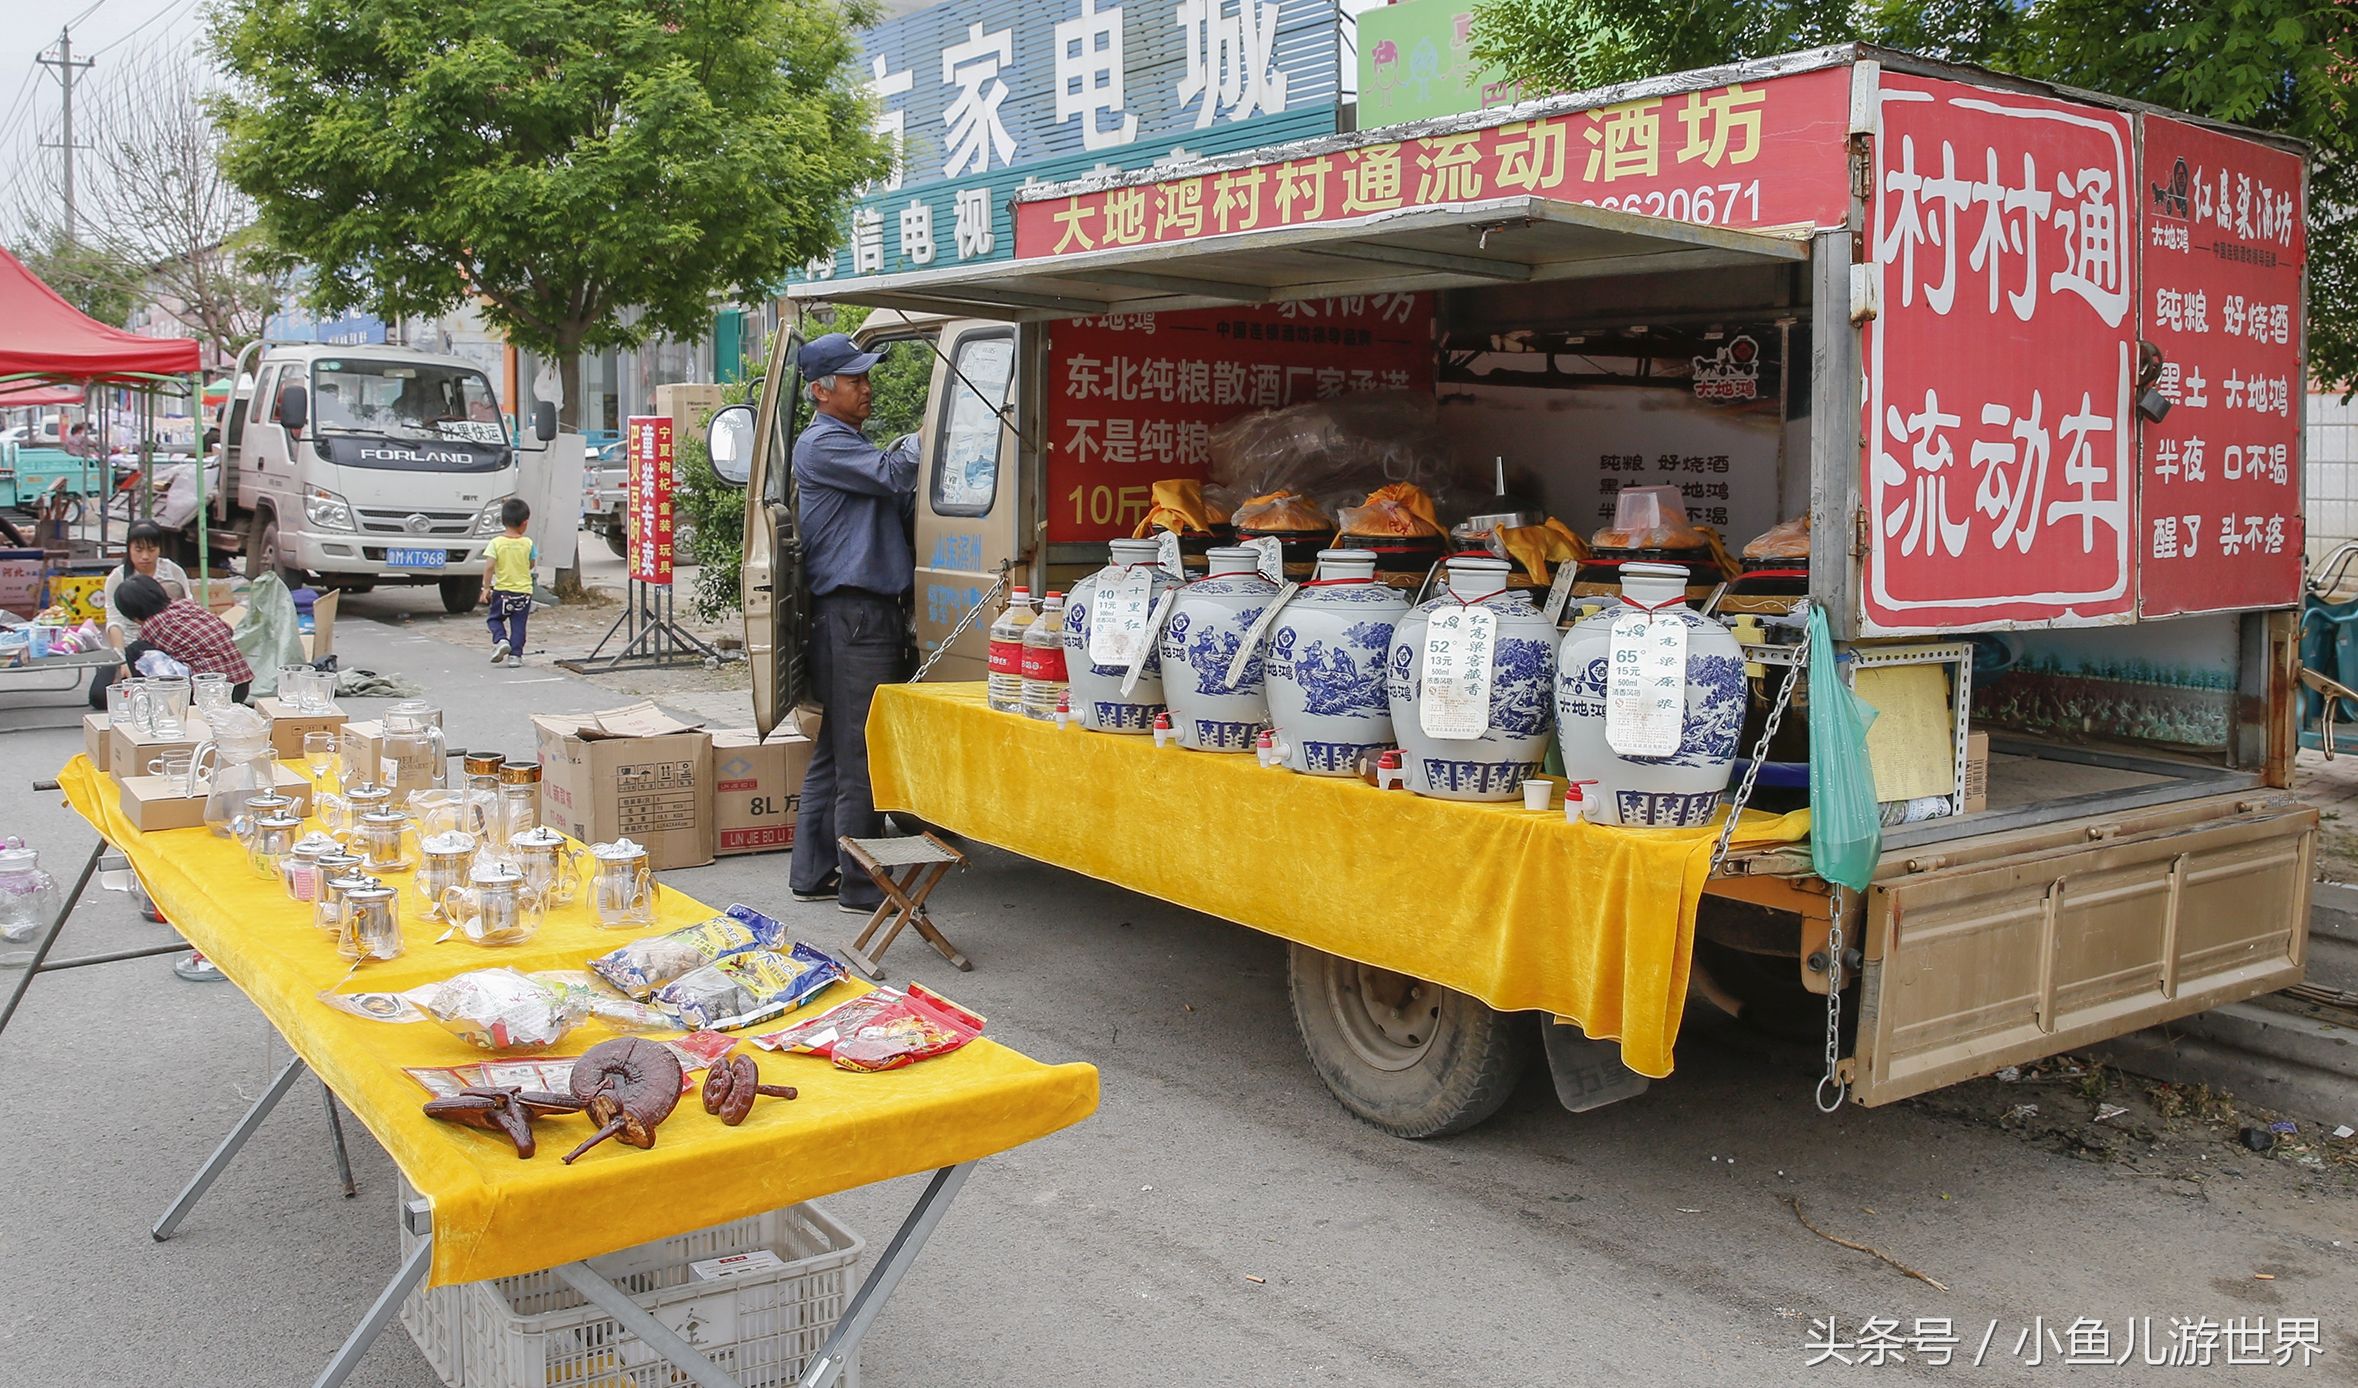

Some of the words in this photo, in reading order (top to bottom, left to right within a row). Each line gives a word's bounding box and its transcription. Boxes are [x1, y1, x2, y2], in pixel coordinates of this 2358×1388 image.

[1052, 84, 1767, 256] 大地鸿村村通流动酒坊
[1885, 134, 2130, 328] 村村通
[2151, 221, 2190, 254] 大地鸿
[2156, 287, 2209, 333] 纯粮
[2223, 295, 2289, 344] 好烧酒
[1694, 378, 1757, 400] 大地鸿
[2158, 362, 2208, 409] 黑土
[2223, 368, 2289, 418] 大地鸿
[361, 449, 473, 464] FORLAND
[1064, 418, 1210, 465] 不是纯粮
[658, 426, 672, 491] 宁夏枸杞
[1599, 454, 1646, 472] 纯粮
[1657, 454, 1730, 473] 好烧酒
[1882, 388, 2115, 557] 流动车
[2153, 435, 2206, 484] 半夜
[2223, 443, 2288, 486] 口不渴
[641, 423, 655, 577] 童装专卖
[1664, 480, 1730, 500] 地鸿
[658, 502, 672, 532] 童装
[2151, 514, 2201, 560] 醒了
[2218, 512, 2286, 556] 头不疼
[658, 543, 672, 574] 玩具
[1124, 571, 1146, 631] 三十里红
[1430, 656, 1453, 666] 13元
[1431, 668, 1450, 676] 500ml
[1594, 665, 1608, 678] 酒
[1616, 666, 1640, 676] 15元
[1617, 679, 1638, 687] 500ml
[750, 796, 779, 816] 8L
[730, 833, 744, 846] LIN
[747, 831, 759, 844] JIE
[762, 830, 774, 843] BO
[778, 829, 786, 840] LI
